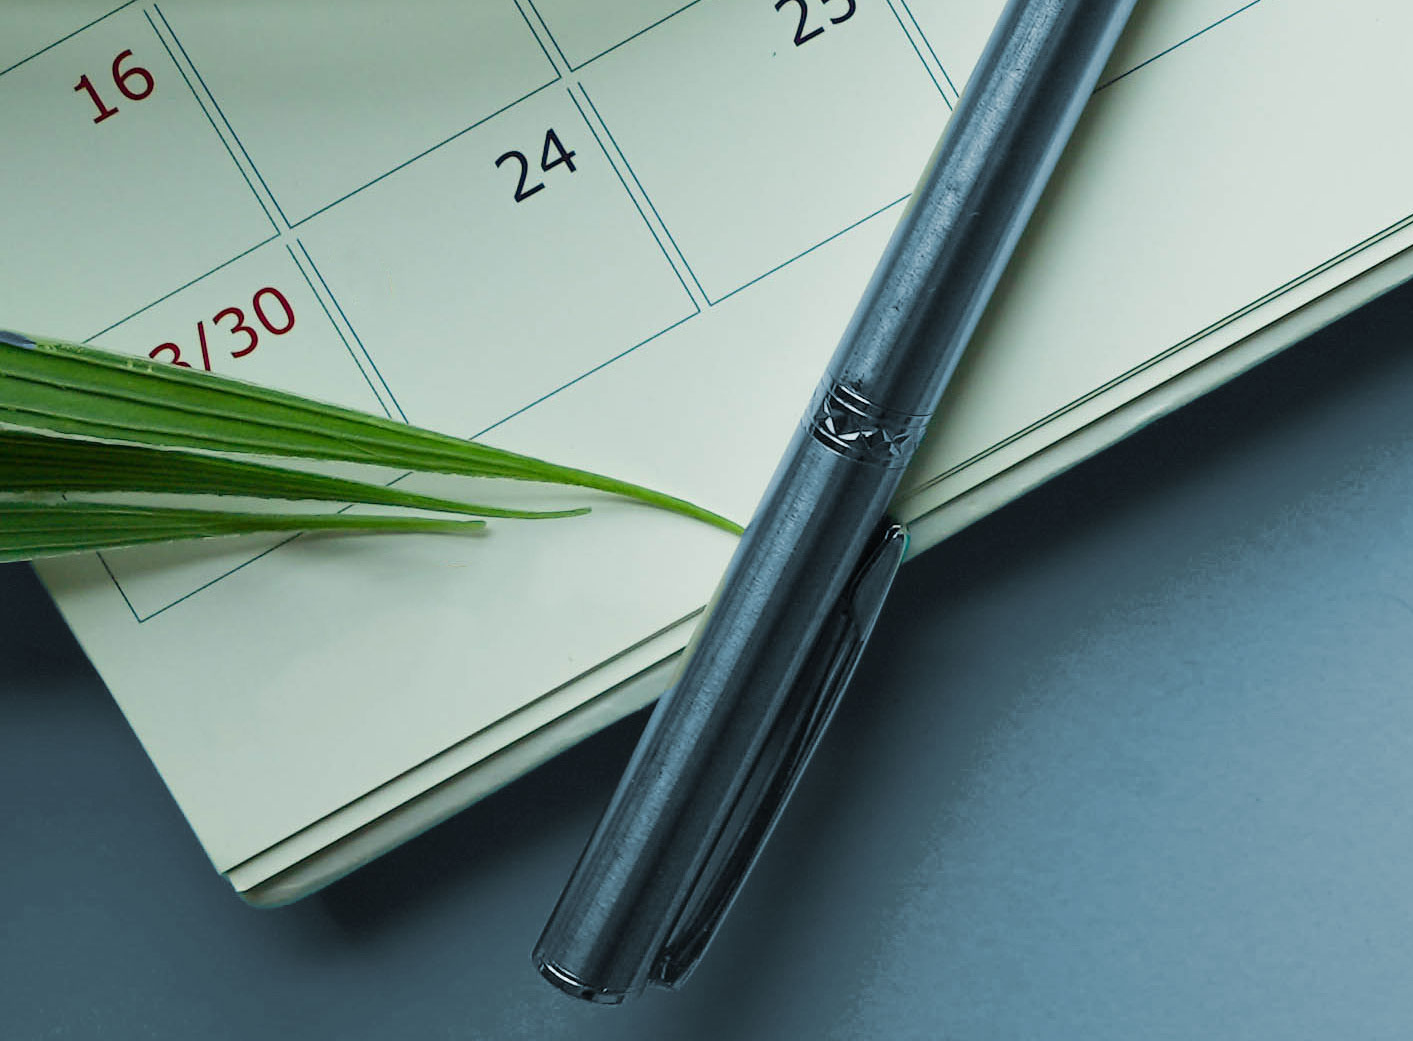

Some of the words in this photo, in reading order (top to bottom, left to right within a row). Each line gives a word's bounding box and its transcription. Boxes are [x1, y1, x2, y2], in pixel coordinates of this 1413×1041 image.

[73, 49, 155, 124] 16
[494, 128, 577, 203] 24
[148, 287, 295, 372] 3/30
